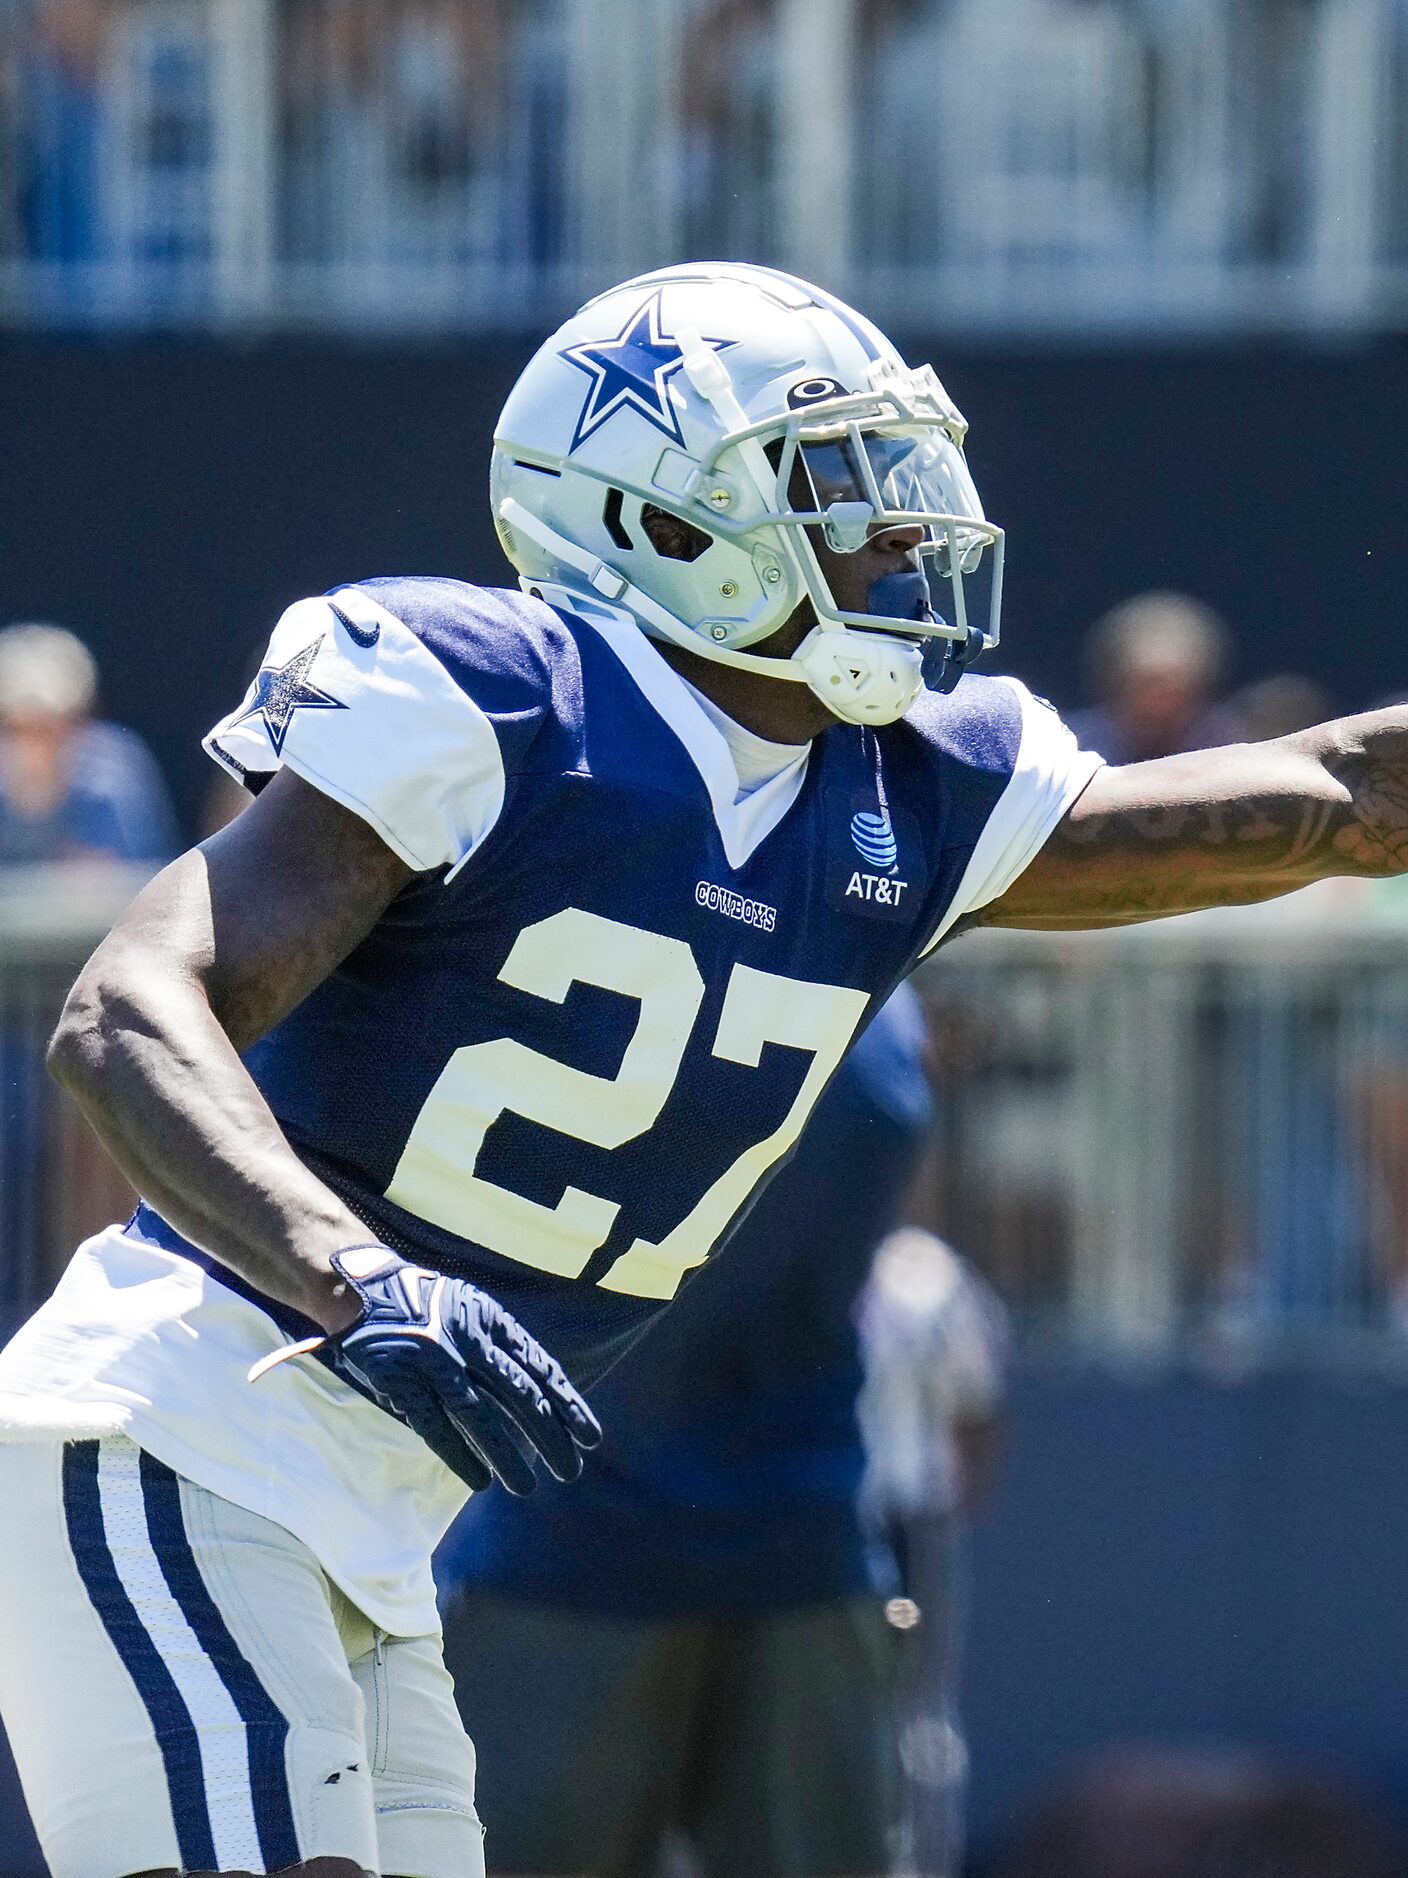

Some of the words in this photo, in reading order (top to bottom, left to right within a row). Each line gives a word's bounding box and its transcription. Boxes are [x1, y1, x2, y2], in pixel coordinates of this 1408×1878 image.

[695, 881, 777, 932] COWBOYS
[845, 872, 907, 906] AT&T
[384, 907, 871, 1300] 27
